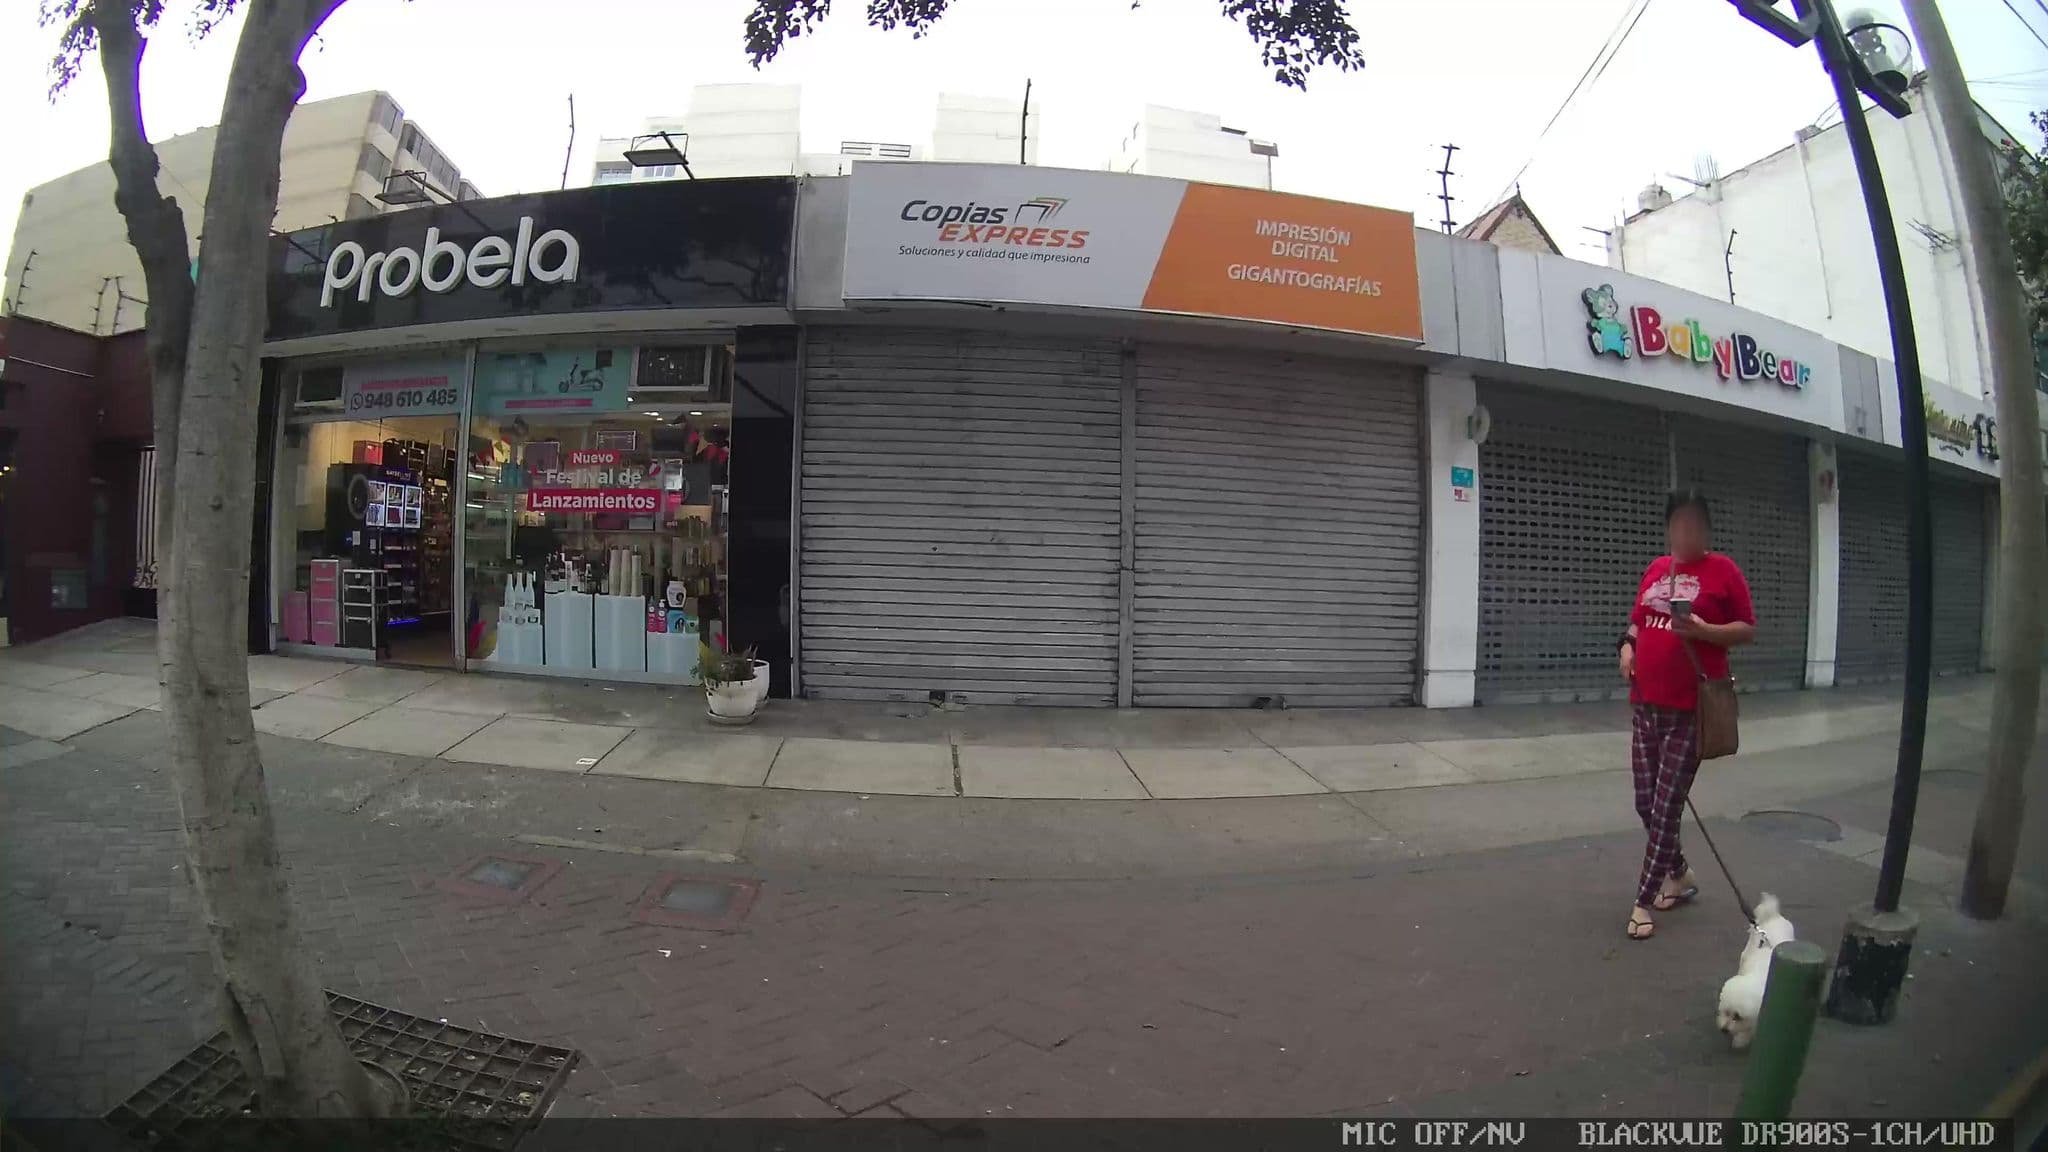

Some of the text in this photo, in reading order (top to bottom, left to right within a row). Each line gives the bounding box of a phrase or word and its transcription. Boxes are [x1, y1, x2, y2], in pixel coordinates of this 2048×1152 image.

[901, 200, 1008, 229] Copias
[938, 223, 1090, 249] EXPRESS
[1255, 219, 1351, 247] IMPRESIÓN
[320, 216, 580, 308] probela
[899, 245, 1090, 264] Soluciones y calidad que impresiona
[1271, 240, 1339, 263] DIGITAL
[1227, 263, 1382, 297] GIGANTOGRAFÍAS
[364, 388, 457, 408] 948 610 485
[573, 453, 614, 464] Nuevo
[546, 468, 642, 486] Festival de
[532, 493, 656, 509] Lanzamientos
